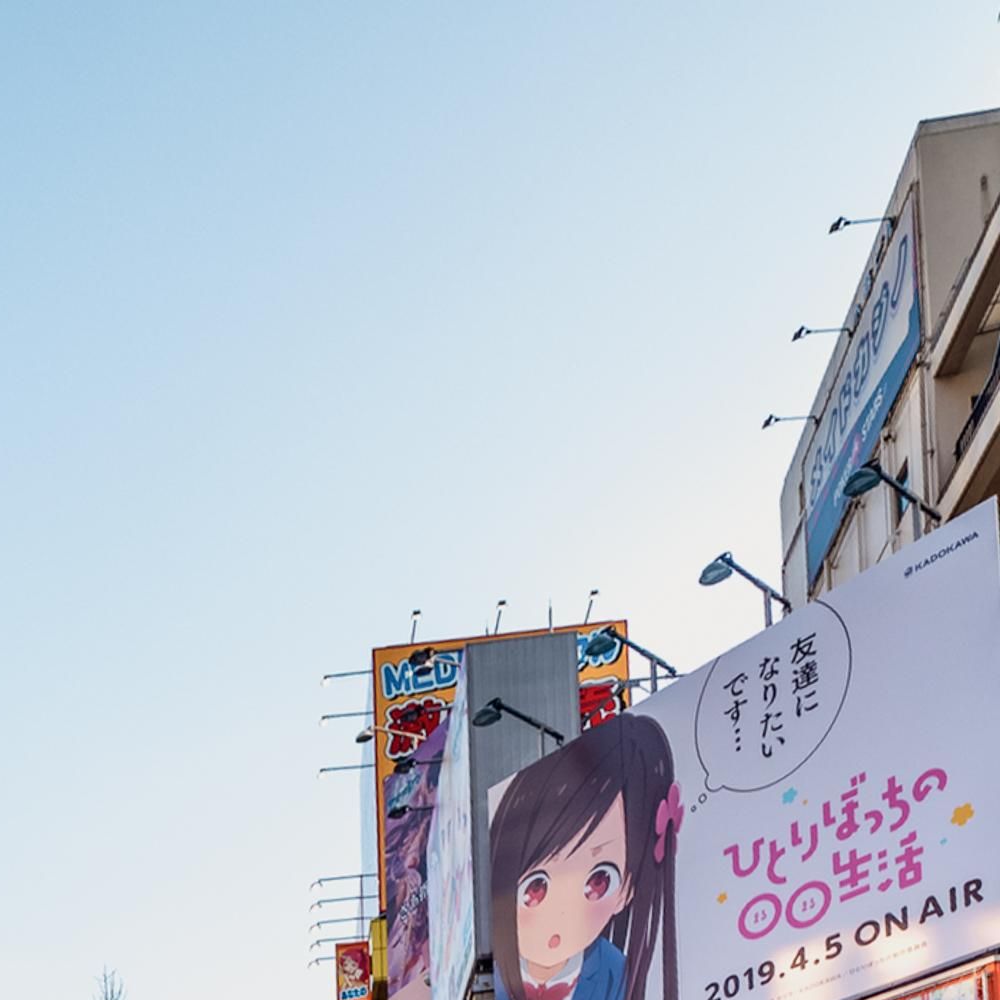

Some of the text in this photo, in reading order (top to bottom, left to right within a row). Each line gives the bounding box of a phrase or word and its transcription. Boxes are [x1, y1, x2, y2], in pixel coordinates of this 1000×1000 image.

[914, 531, 979, 573] KADOKAWA
[759, 657, 786, 758] なりたい
[790, 633, 819, 717] 友達に
[723, 767, 948, 885] ひとりぼっちの
[854, 905, 909, 947] ON
[919, 878, 985, 924] AIR
